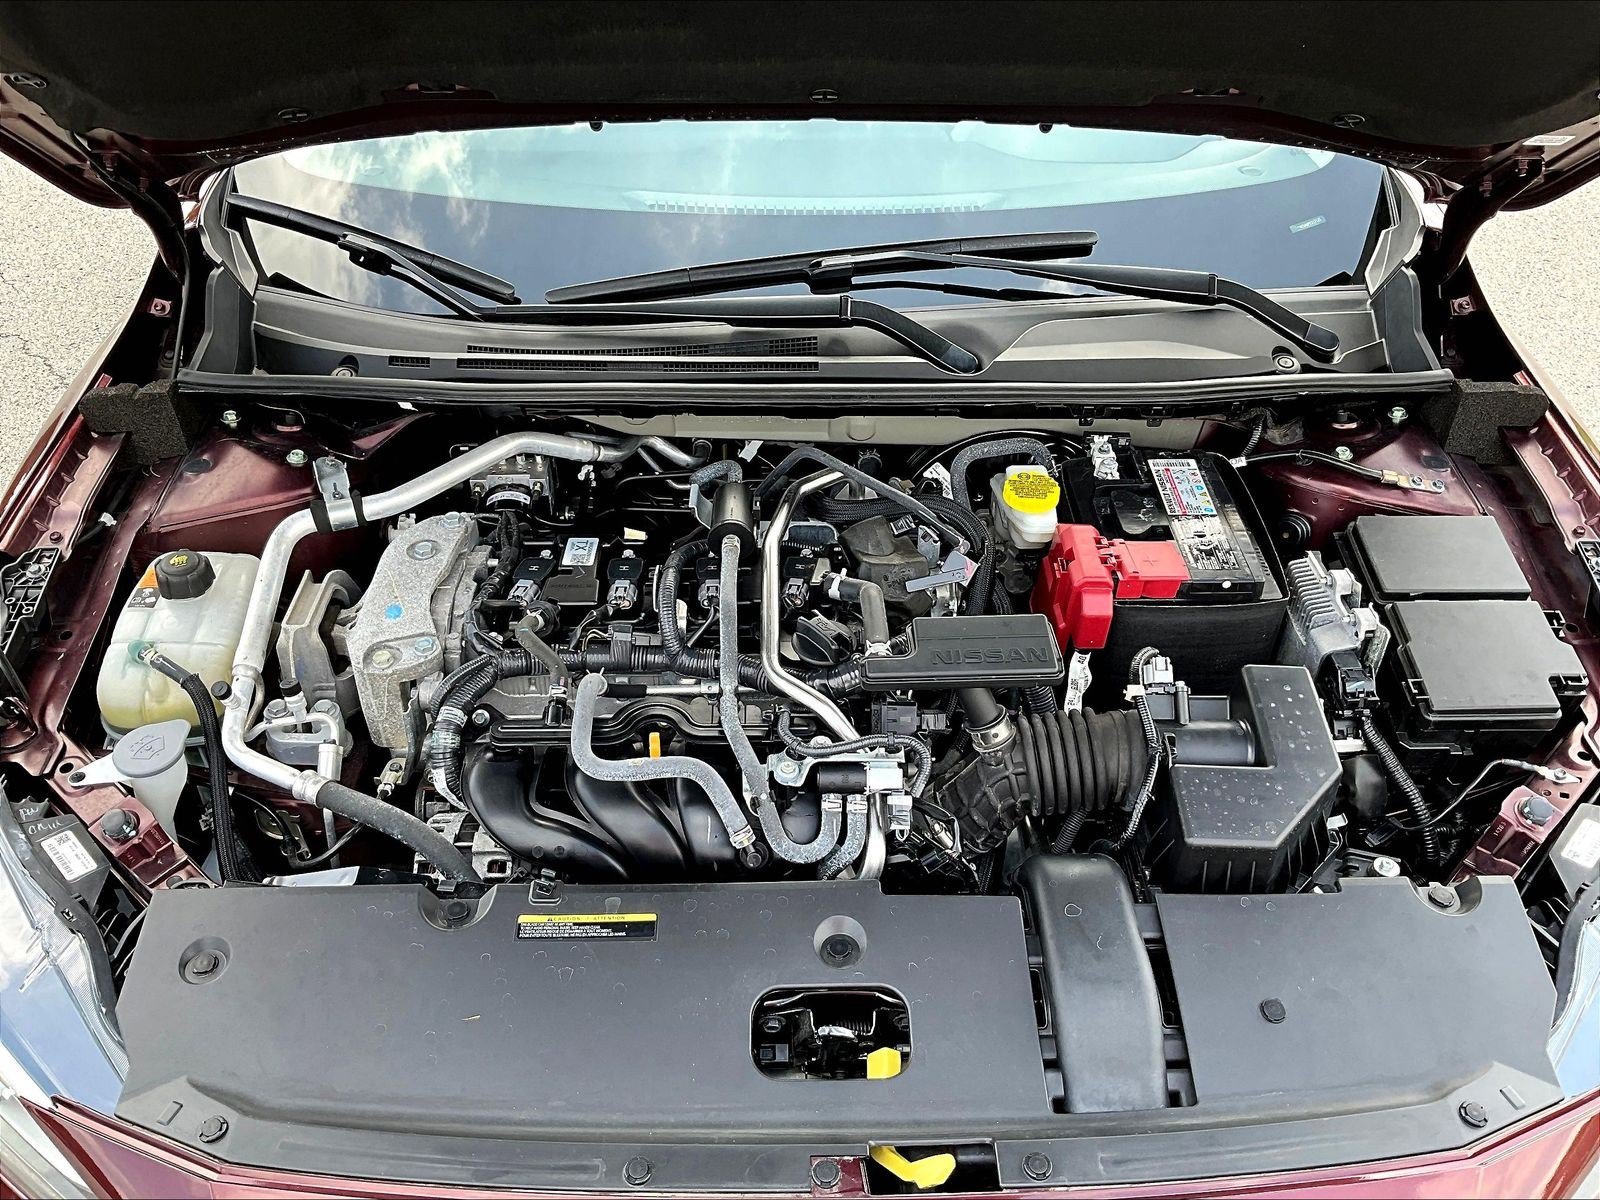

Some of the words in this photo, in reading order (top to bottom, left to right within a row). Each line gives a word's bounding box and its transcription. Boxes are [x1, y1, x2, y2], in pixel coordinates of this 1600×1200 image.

[1154, 469, 1169, 491] NISSAN
[575, 540, 588, 551] TX
[933, 648, 1049, 665] NISSAN
